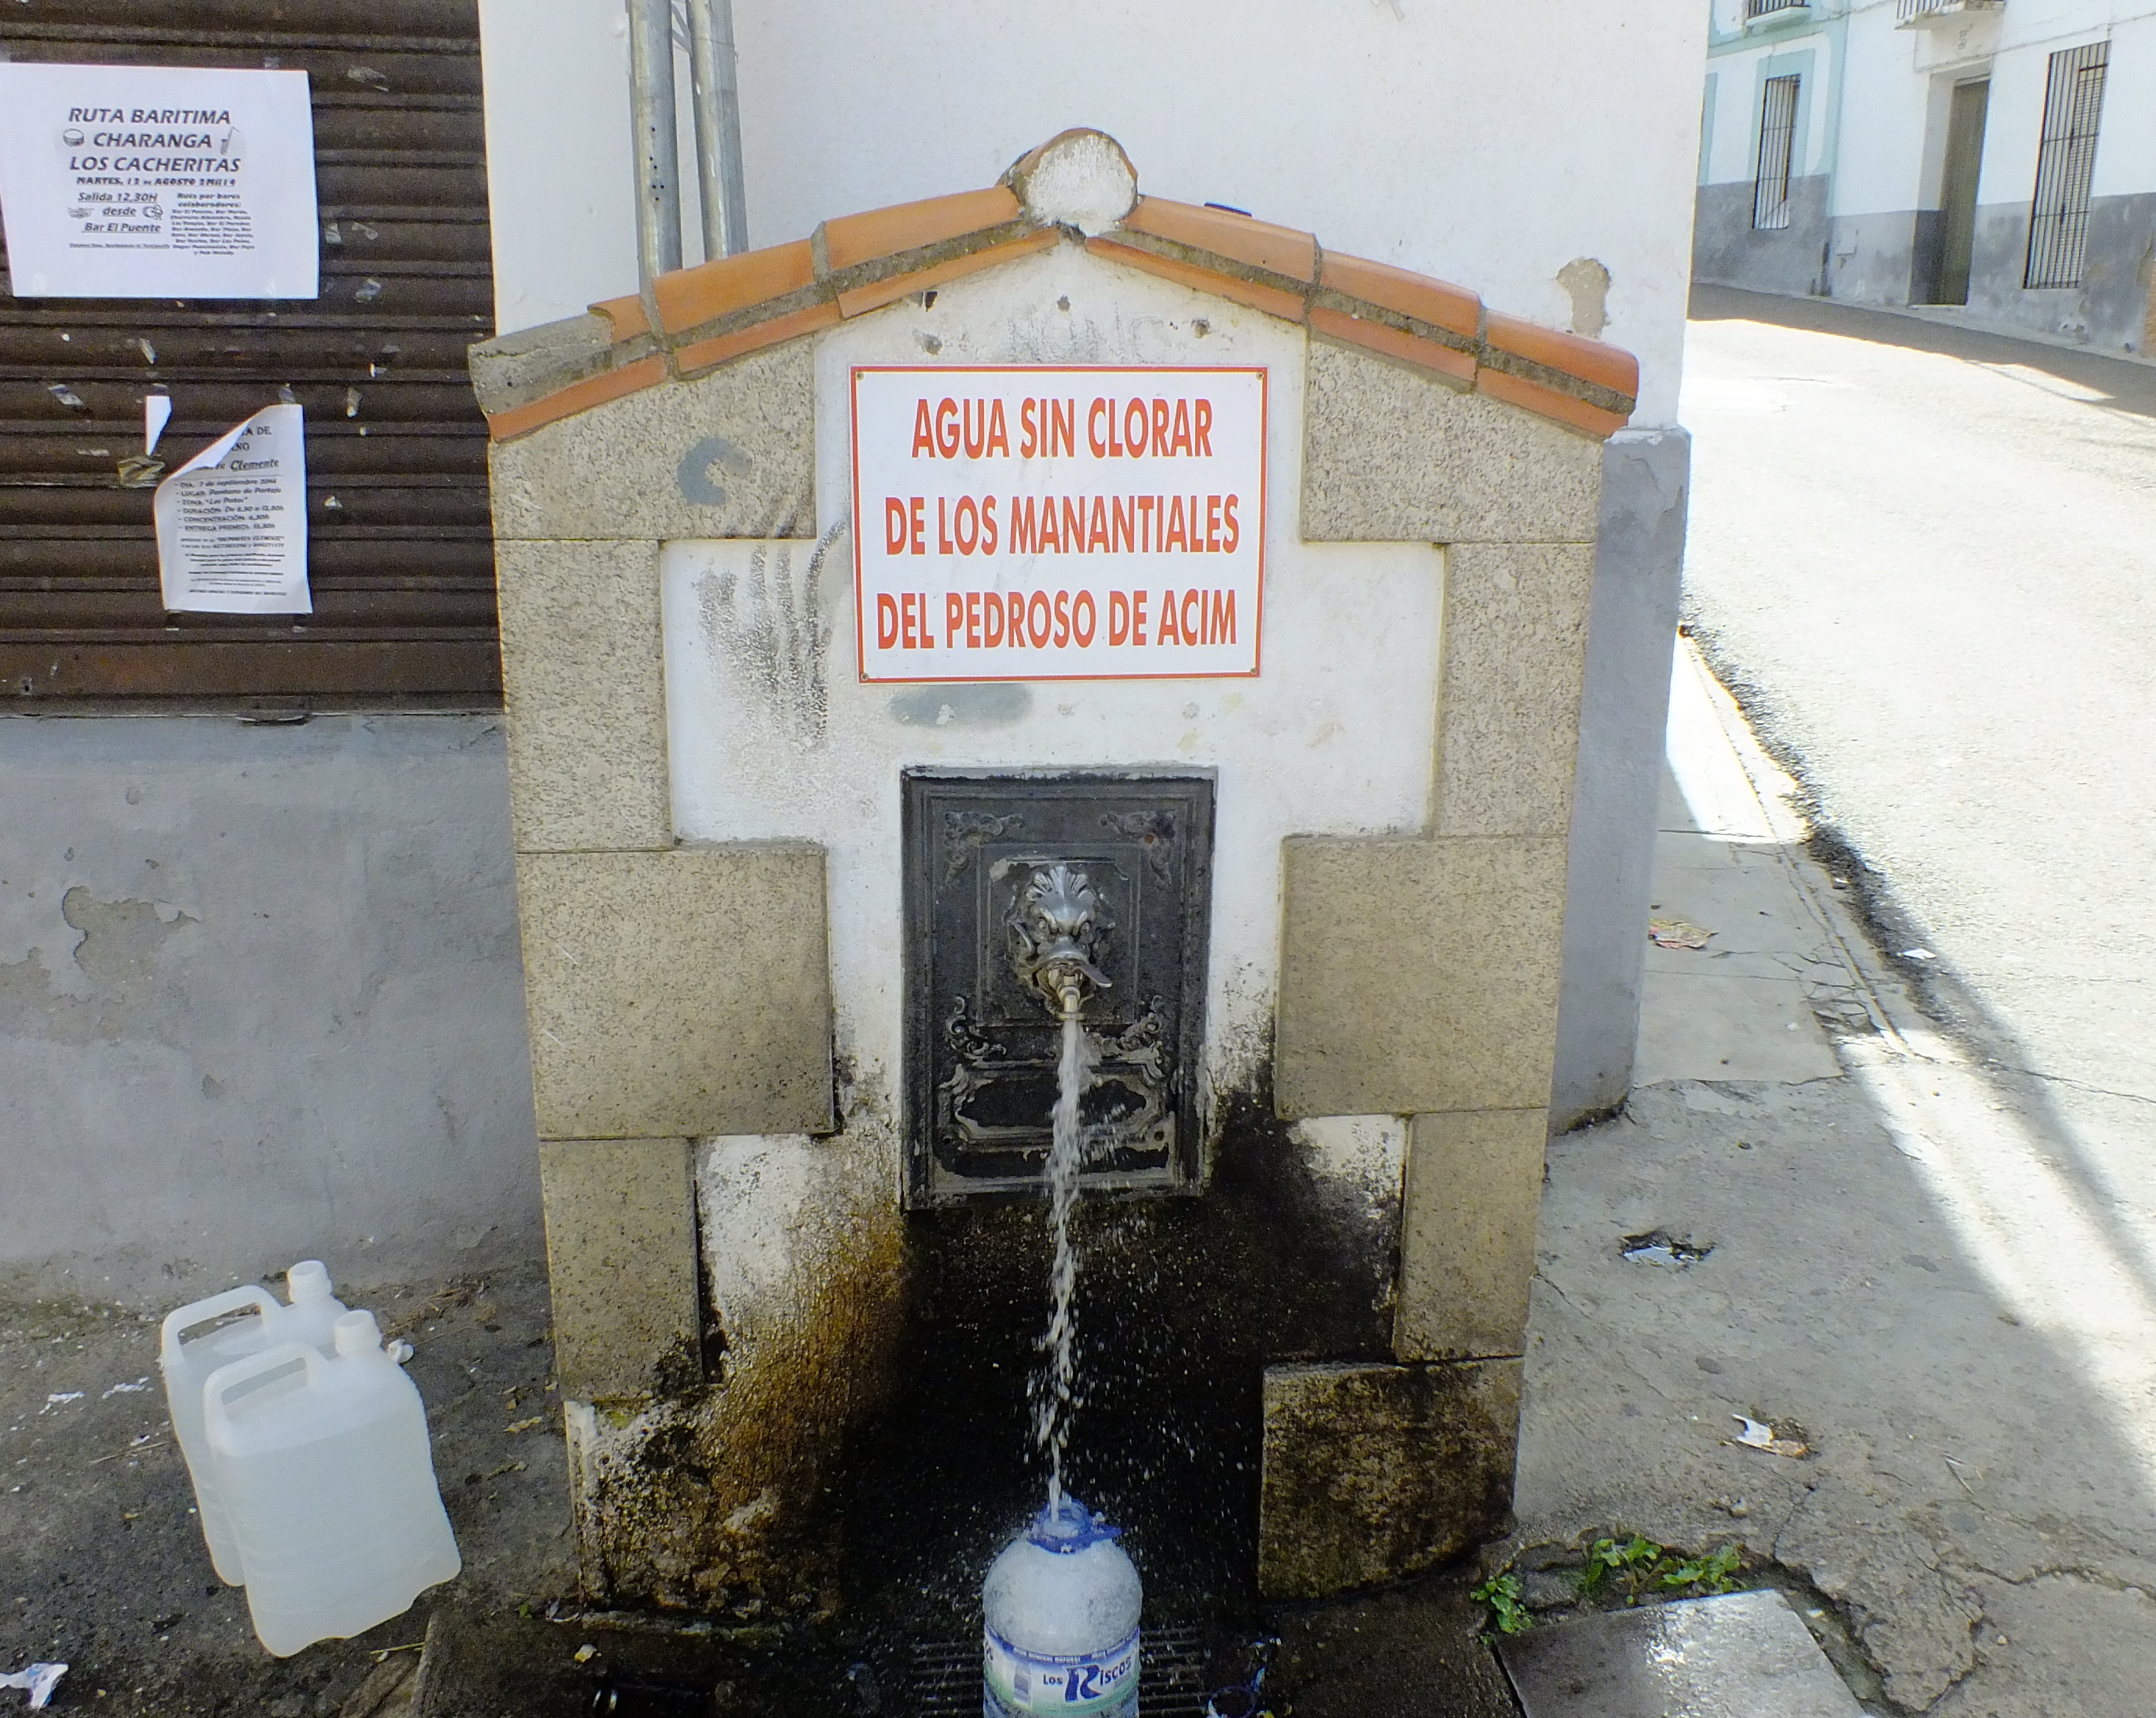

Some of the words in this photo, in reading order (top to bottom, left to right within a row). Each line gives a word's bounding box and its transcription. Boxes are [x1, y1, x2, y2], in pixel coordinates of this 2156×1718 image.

[68, 108, 125, 123] RUTA
[130, 108, 231, 124] BARITIMA
[93, 132, 213, 148] CHARANGA
[69, 156, 109, 171] LOS
[114, 157, 242, 172] CACHERITAS
[78, 192, 113, 201] Salida
[102, 206, 137, 215] desde
[85, 223, 105, 231] Bar
[107, 223, 119, 232] El
[121, 223, 162, 232] Puente
[257, 426, 272, 436] DE
[912, 397, 1009, 459] AGUA
[1020, 397, 1074, 459] SIN
[1088, 397, 1212, 459] CLORAR
[230, 459, 280, 471] Clemente
[885, 496, 926, 555] DE
[938, 495, 998, 556] LOS
[1010, 494, 1239, 554] MANANTIALES
[876, 592, 935, 650] DEL
[946, 591, 1096, 649] PEDROSO
[1108, 591, 1147, 646] DE
[1157, 589, 1236, 646] ACIM
[1042, 1673, 1063, 1685] Los
